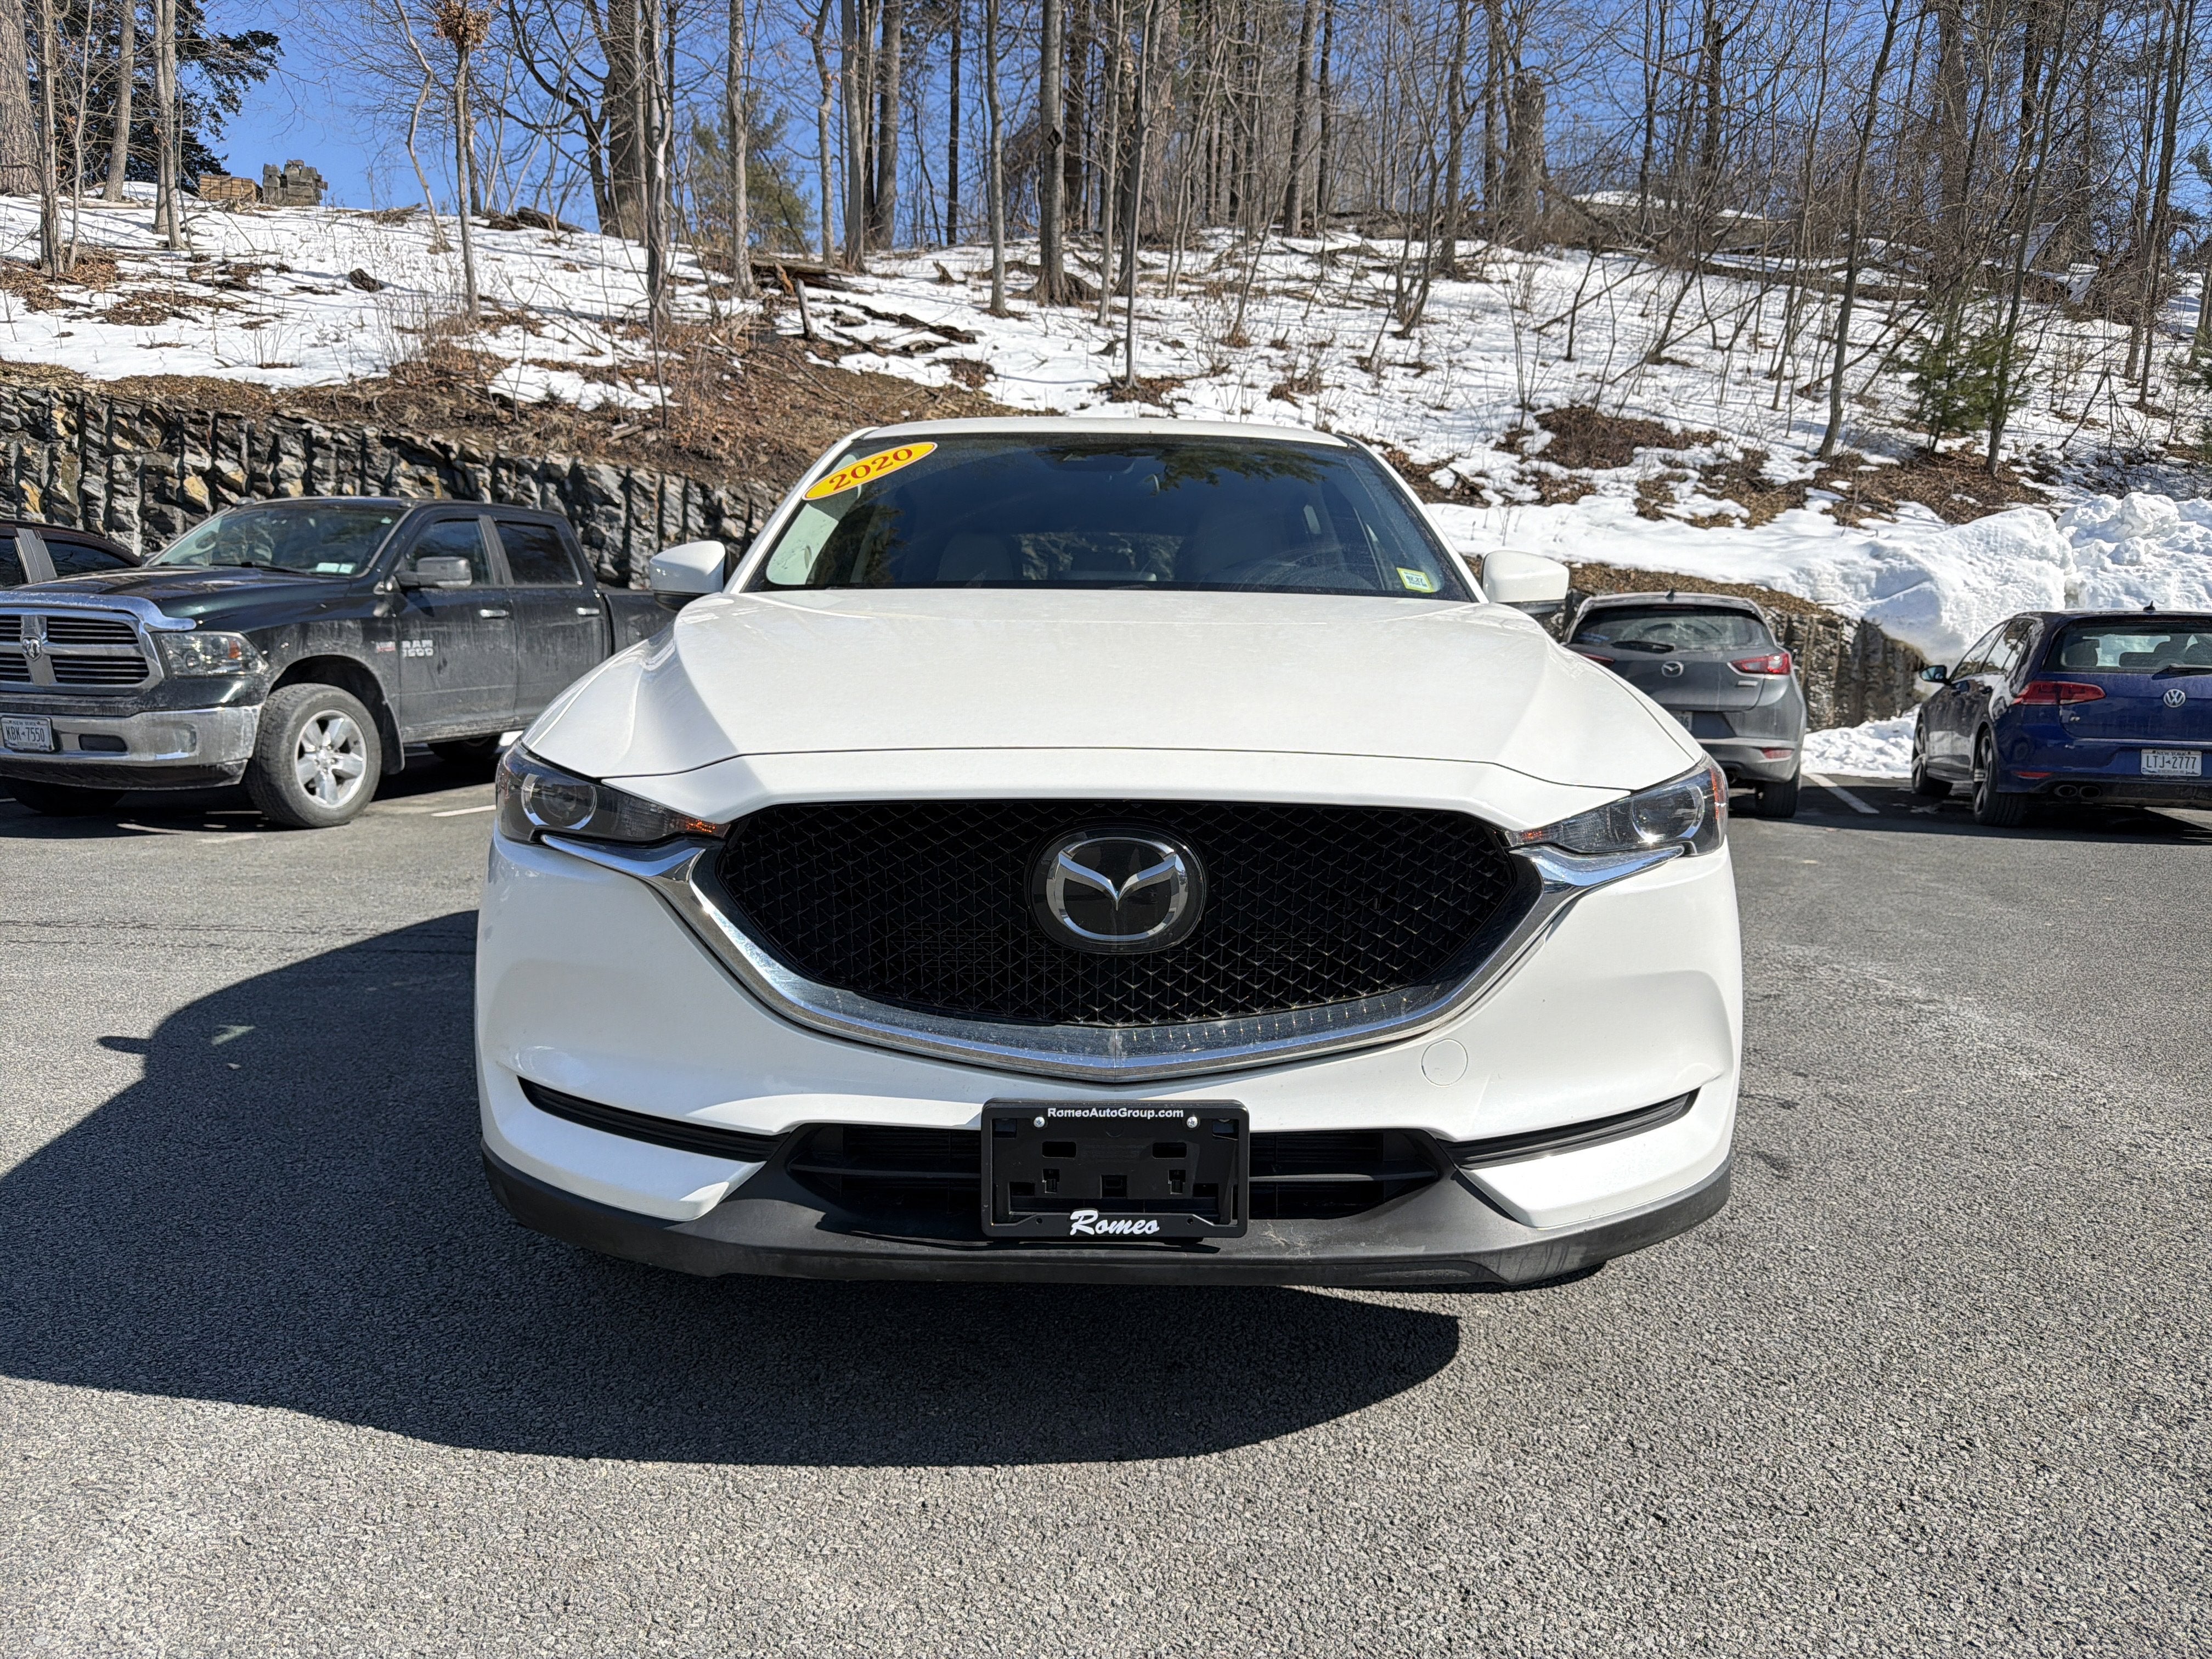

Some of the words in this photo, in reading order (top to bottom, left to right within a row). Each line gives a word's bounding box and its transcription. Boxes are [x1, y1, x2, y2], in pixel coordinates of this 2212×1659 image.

[829, 448, 913, 491] 2020
[402, 640, 433, 648] RAM
[1047, 1108, 1184, 1120] RomeoAutoGroup.com
[1070, 1209, 1160, 1235] Romeo
